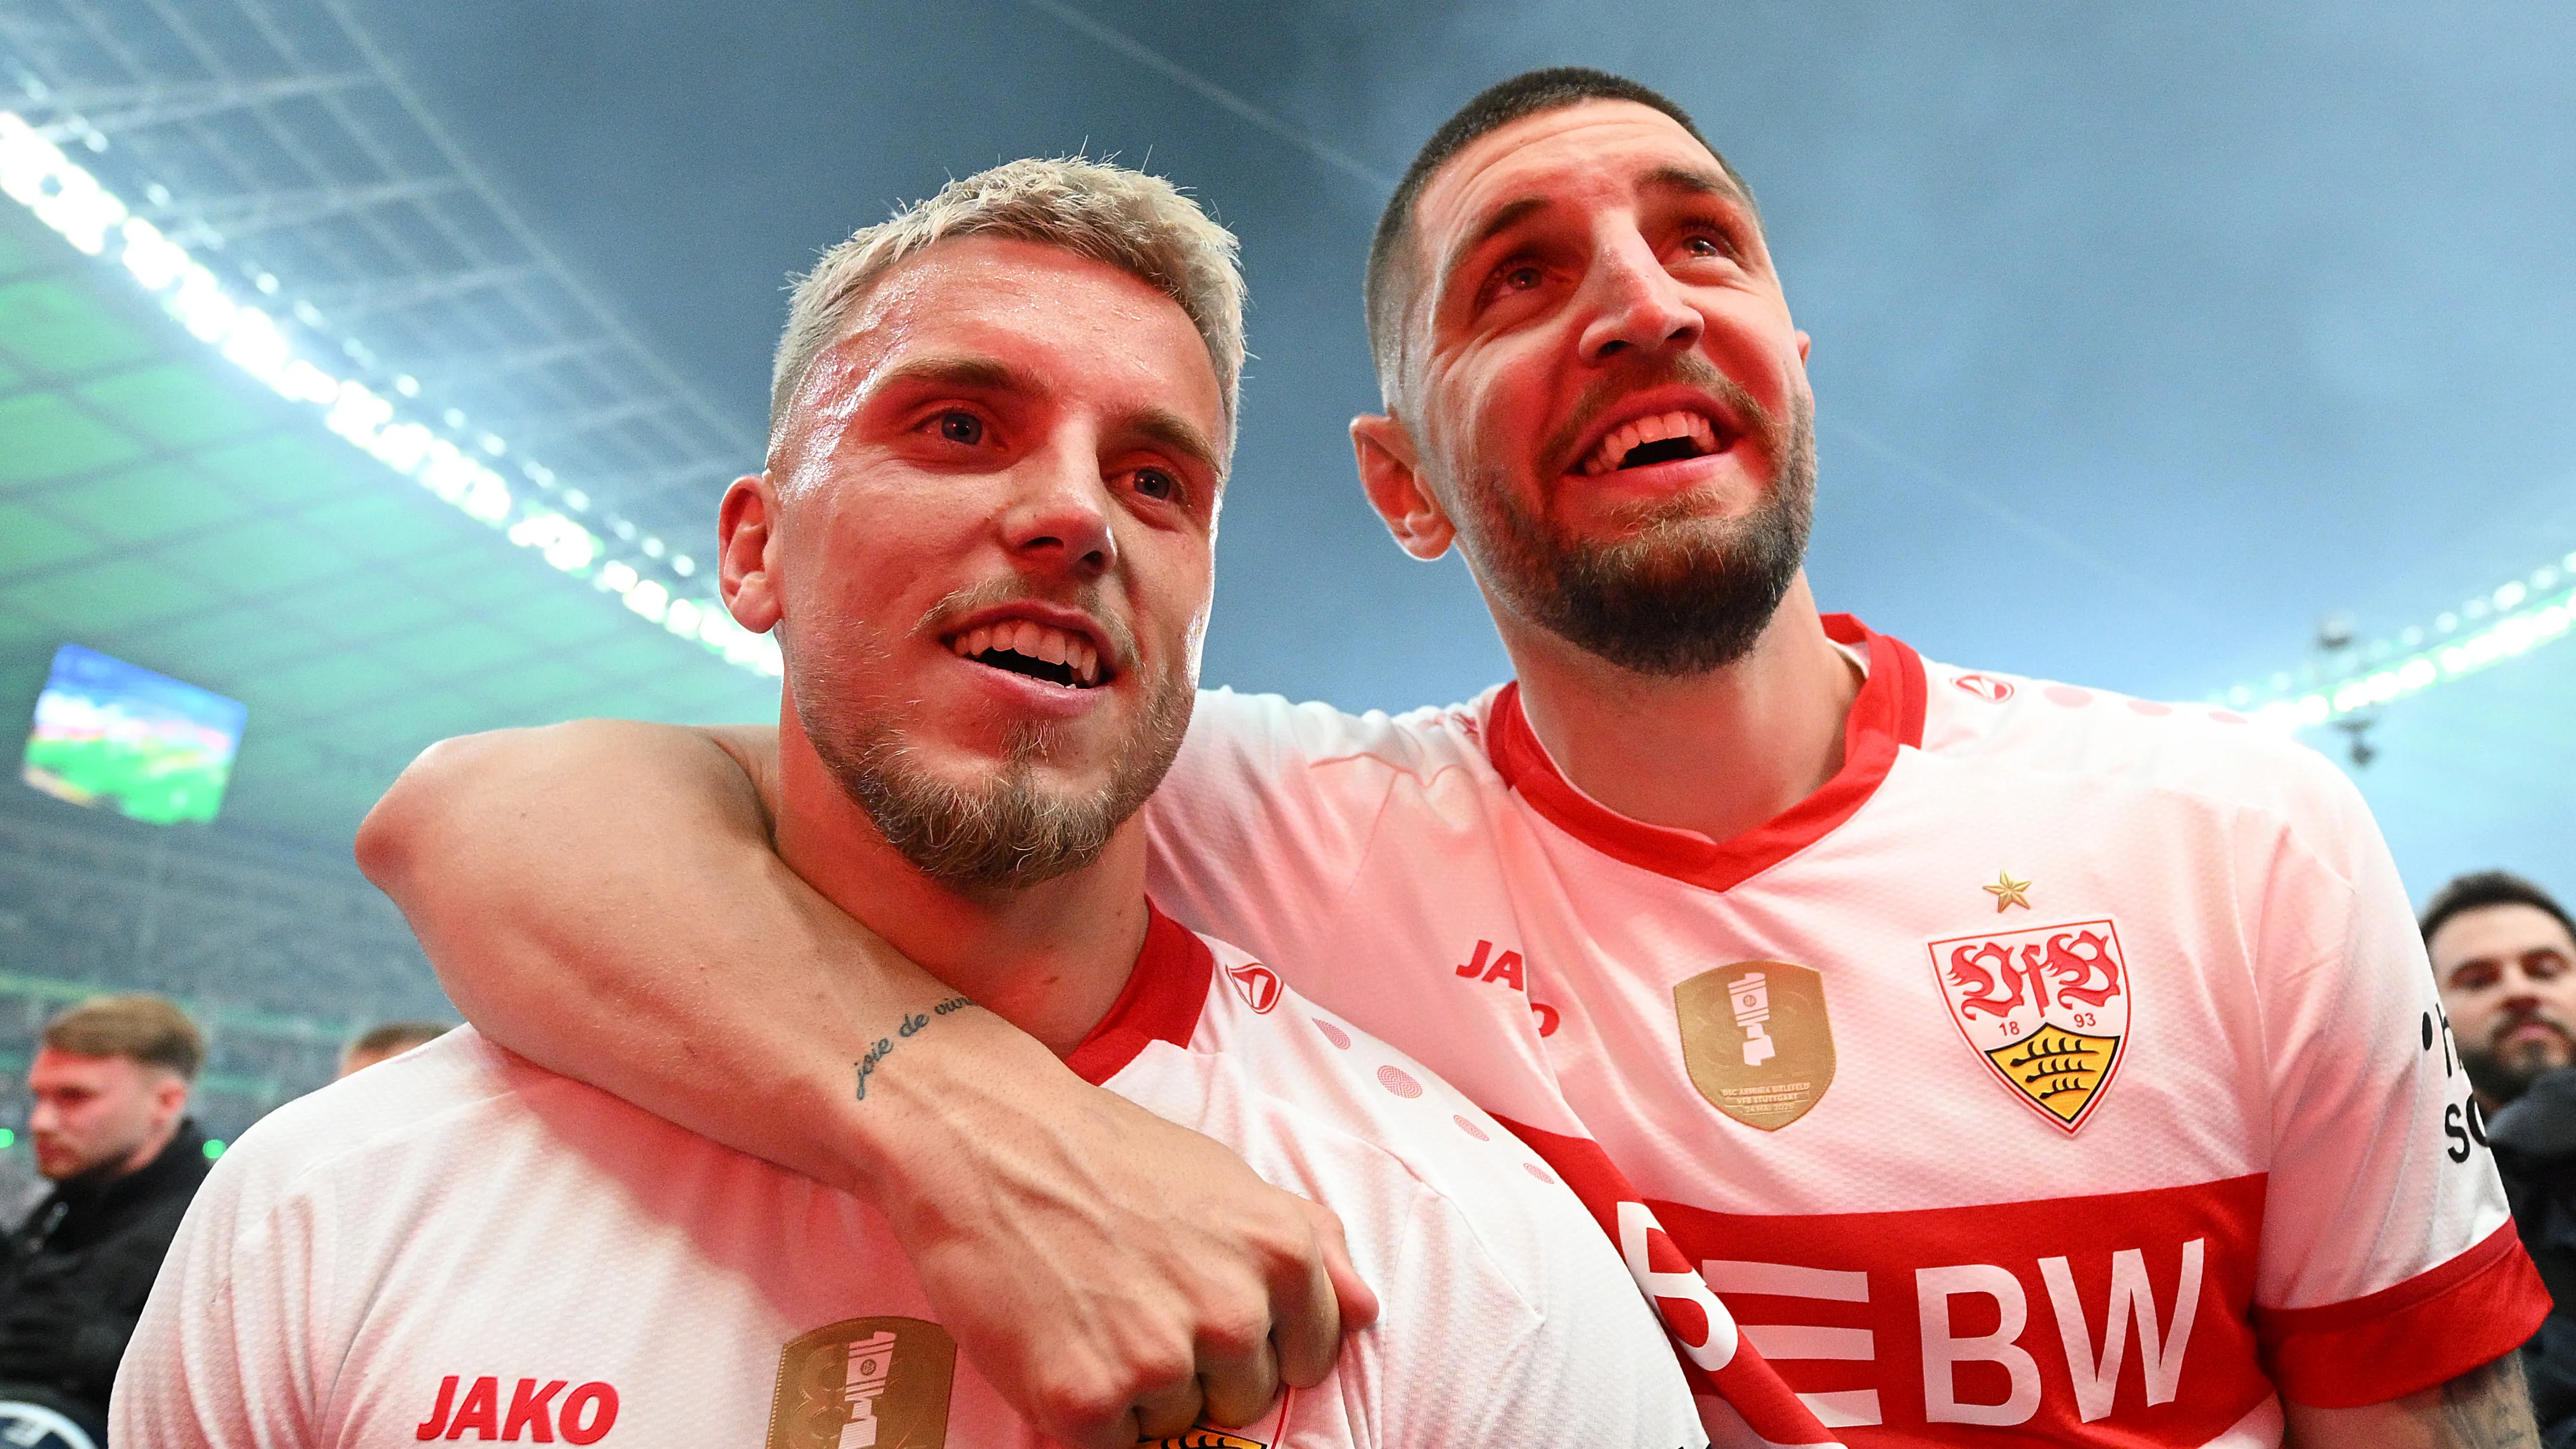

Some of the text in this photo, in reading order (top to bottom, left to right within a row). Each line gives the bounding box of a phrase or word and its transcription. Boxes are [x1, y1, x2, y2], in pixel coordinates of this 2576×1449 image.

[1455, 939, 1560, 1038] JAO
[1998, 1012, 2097, 1037] 18 93
[854, 1038, 893, 1100] joie
[899, 1013, 930, 1037] de
[1739, 1086, 1771, 1095] ARMINIA
[1772, 1082, 1810, 1093] BIELEFELD
[1753, 1093, 1798, 1103] STUTTGART
[1774, 1103, 1795, 1111] 2025
[416, 1375, 620, 1445] JAKO
